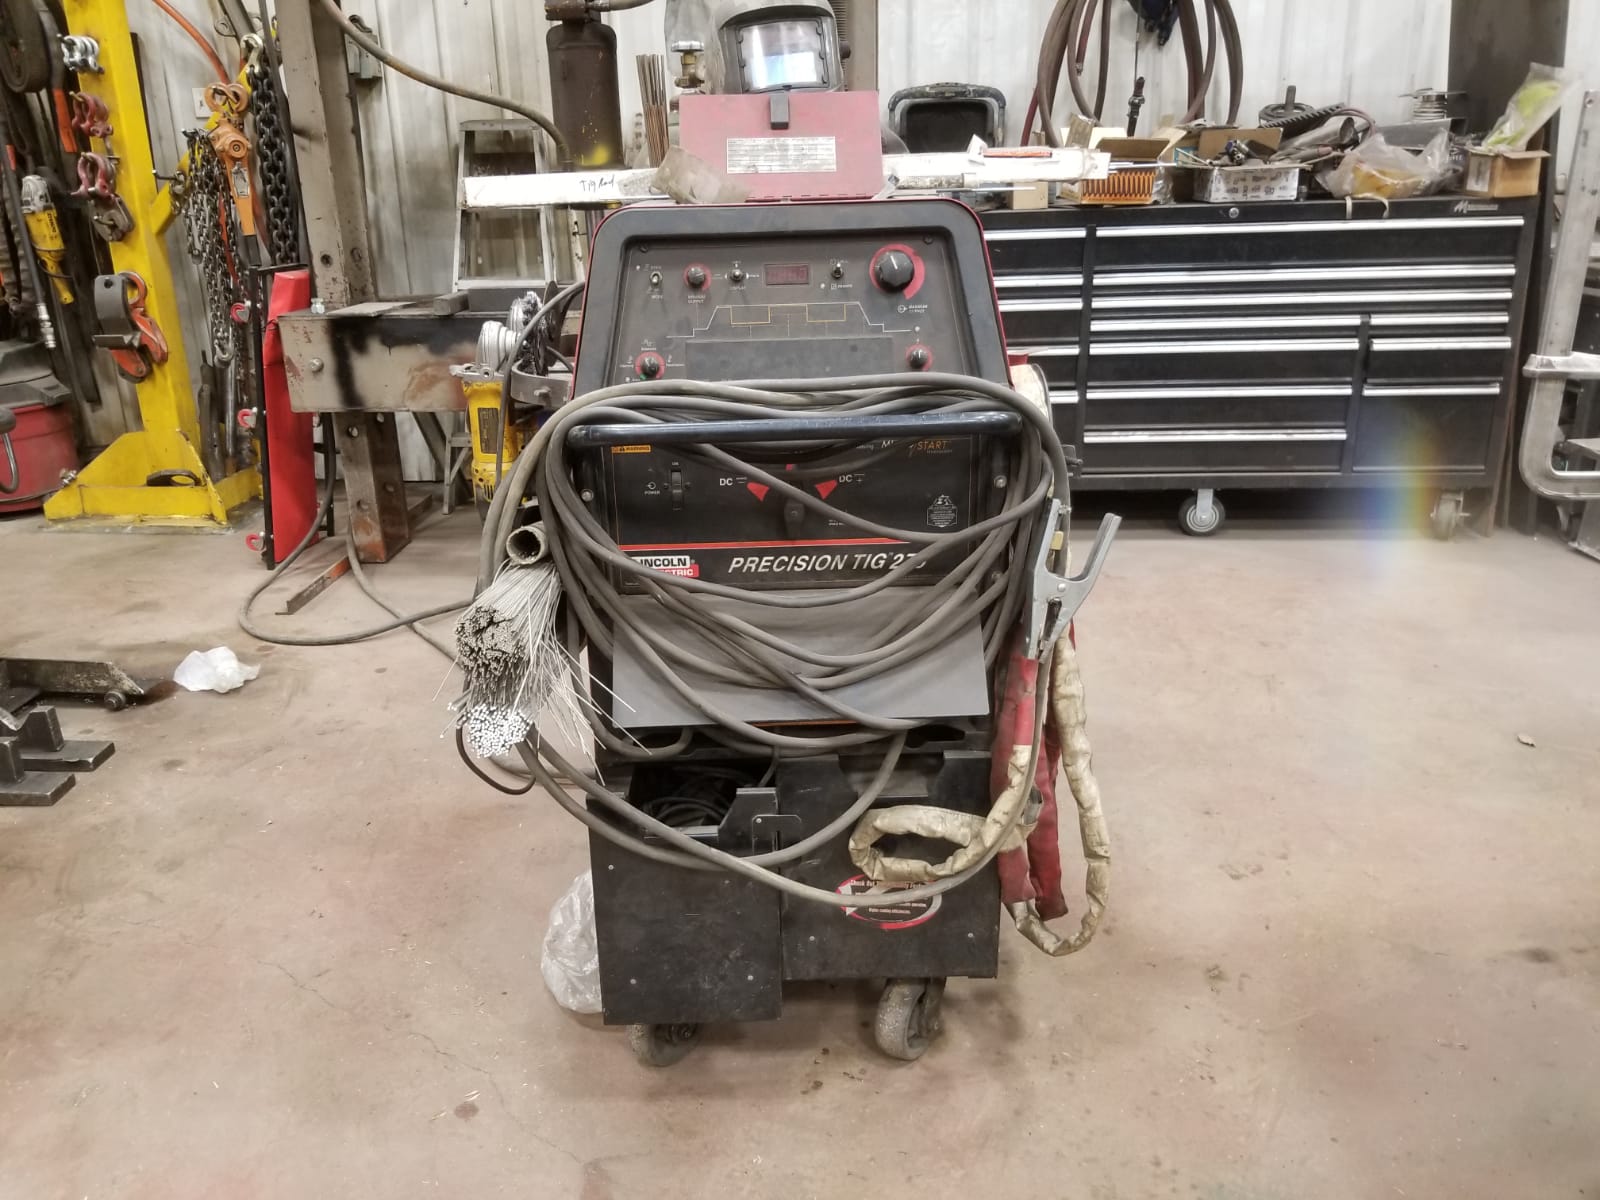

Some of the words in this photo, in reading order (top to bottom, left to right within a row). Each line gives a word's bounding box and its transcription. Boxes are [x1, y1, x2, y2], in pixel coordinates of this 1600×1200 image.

[719, 477, 733, 487] DC
[839, 474, 853, 483] DC
[640, 557, 687, 567] INCOLN
[728, 554, 848, 573] PRECISION
[852, 552, 888, 570] TIG
